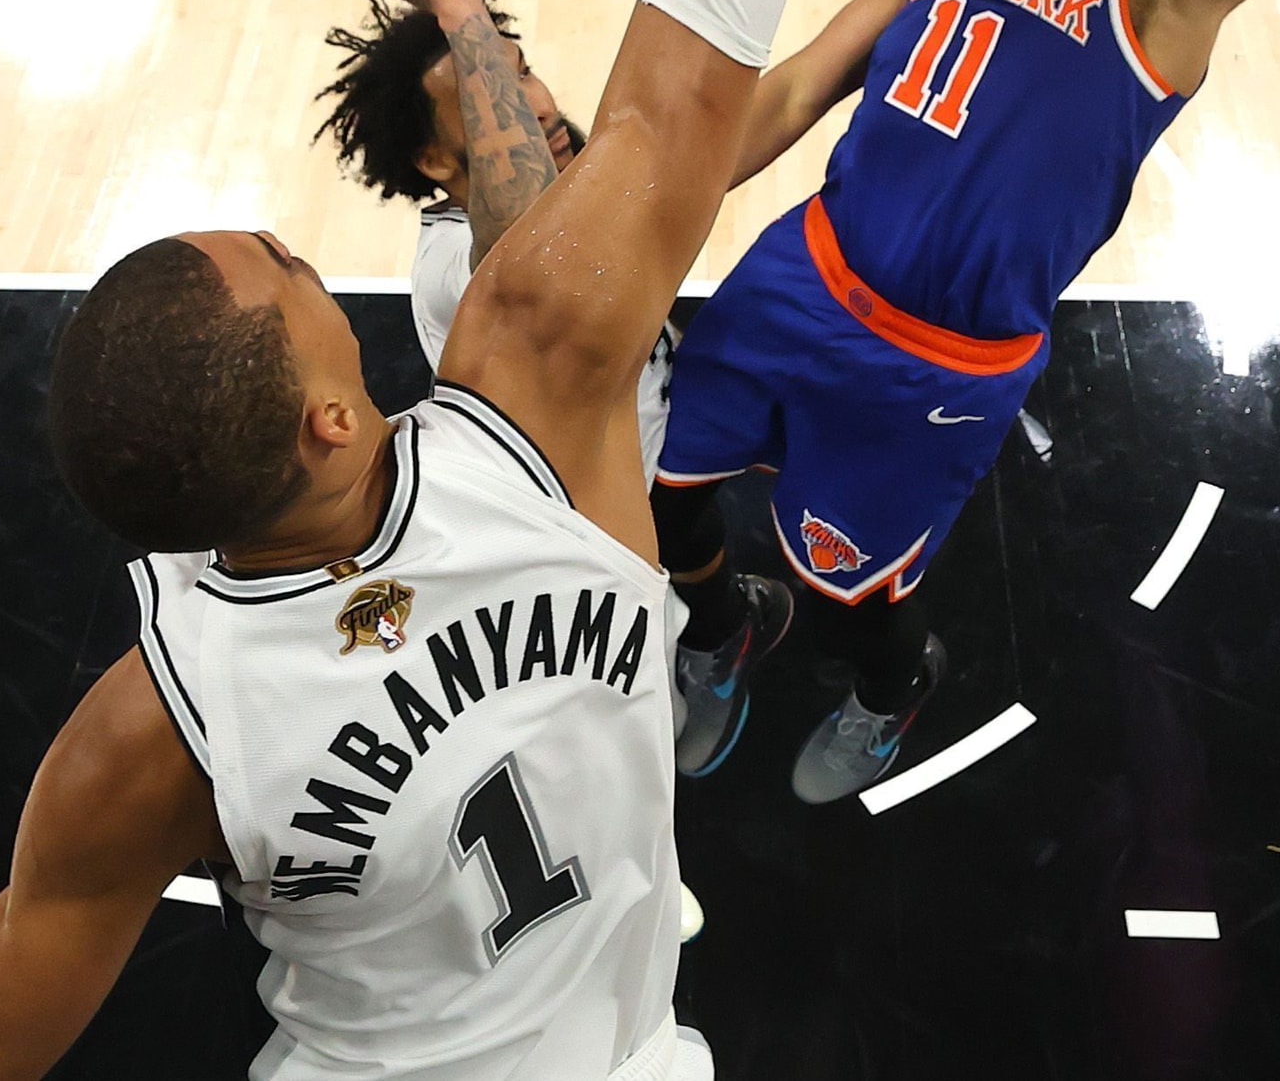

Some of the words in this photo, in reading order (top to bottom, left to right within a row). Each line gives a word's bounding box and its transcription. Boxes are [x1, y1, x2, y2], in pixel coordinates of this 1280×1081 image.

[339, 582, 412, 652] Finals
[271, 589, 648, 902] WEMBANYAMA
[447, 750, 592, 969] 1
